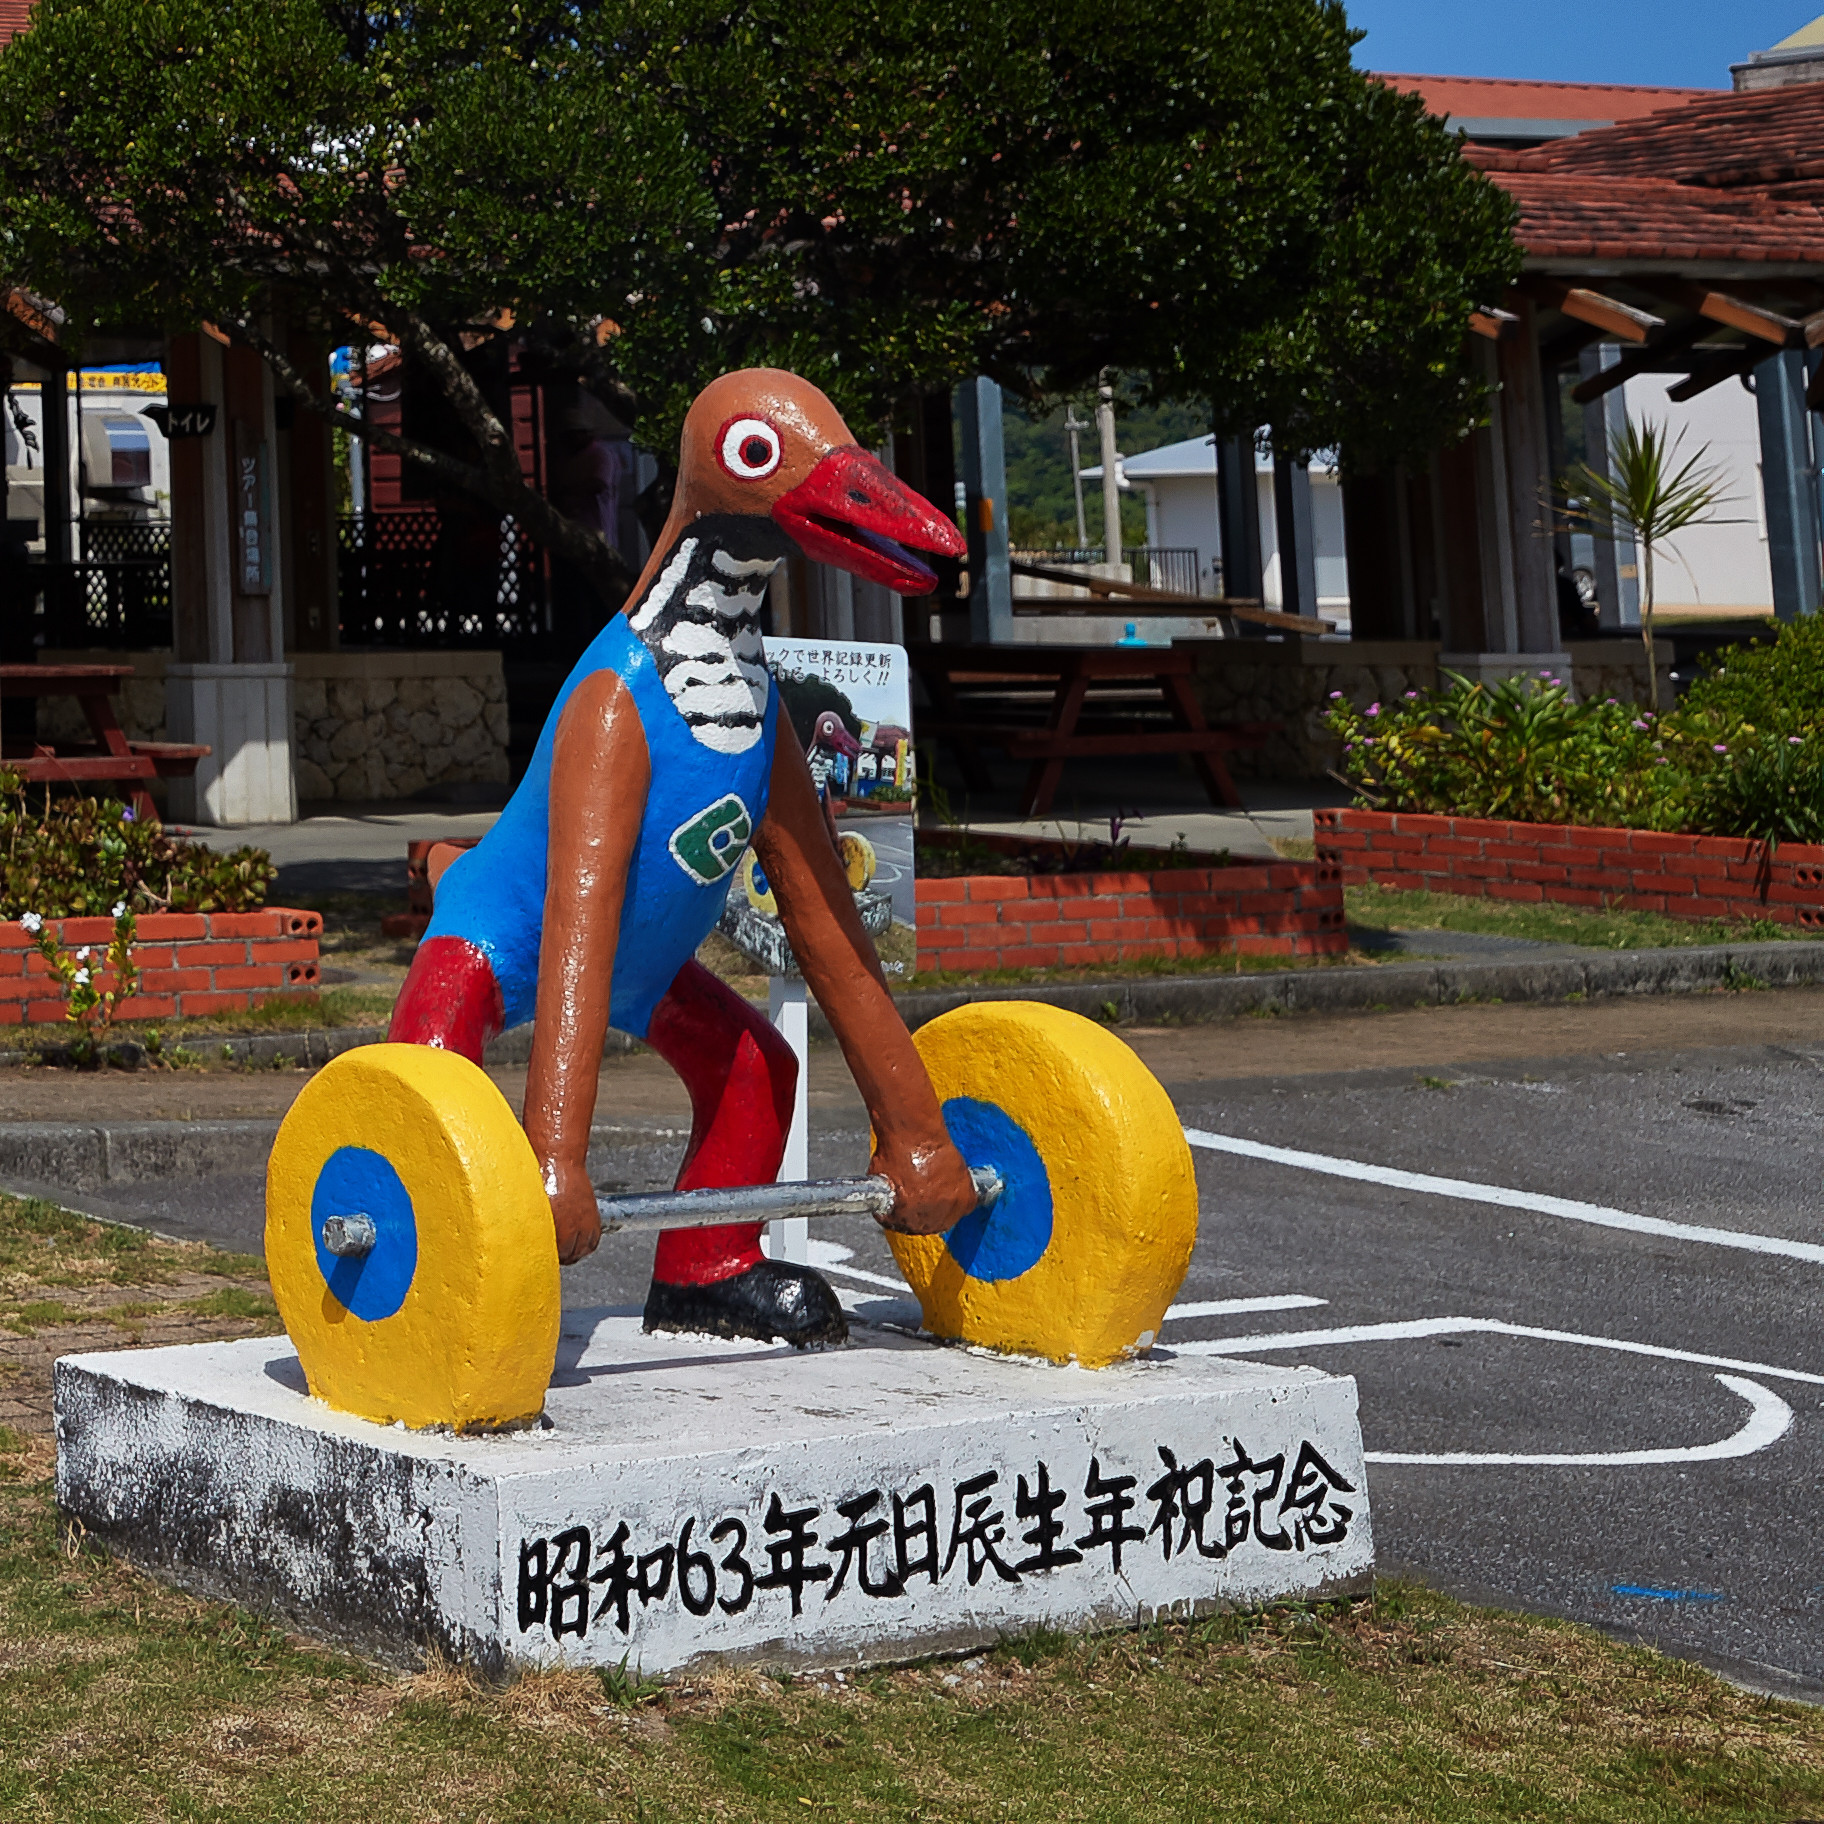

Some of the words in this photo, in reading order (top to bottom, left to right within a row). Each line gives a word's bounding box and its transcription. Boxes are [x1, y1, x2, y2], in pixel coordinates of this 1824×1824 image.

[167, 411, 211, 434] トイレ
[516, 1439, 1357, 1641] 昭和63年元日辰生年祝記念
